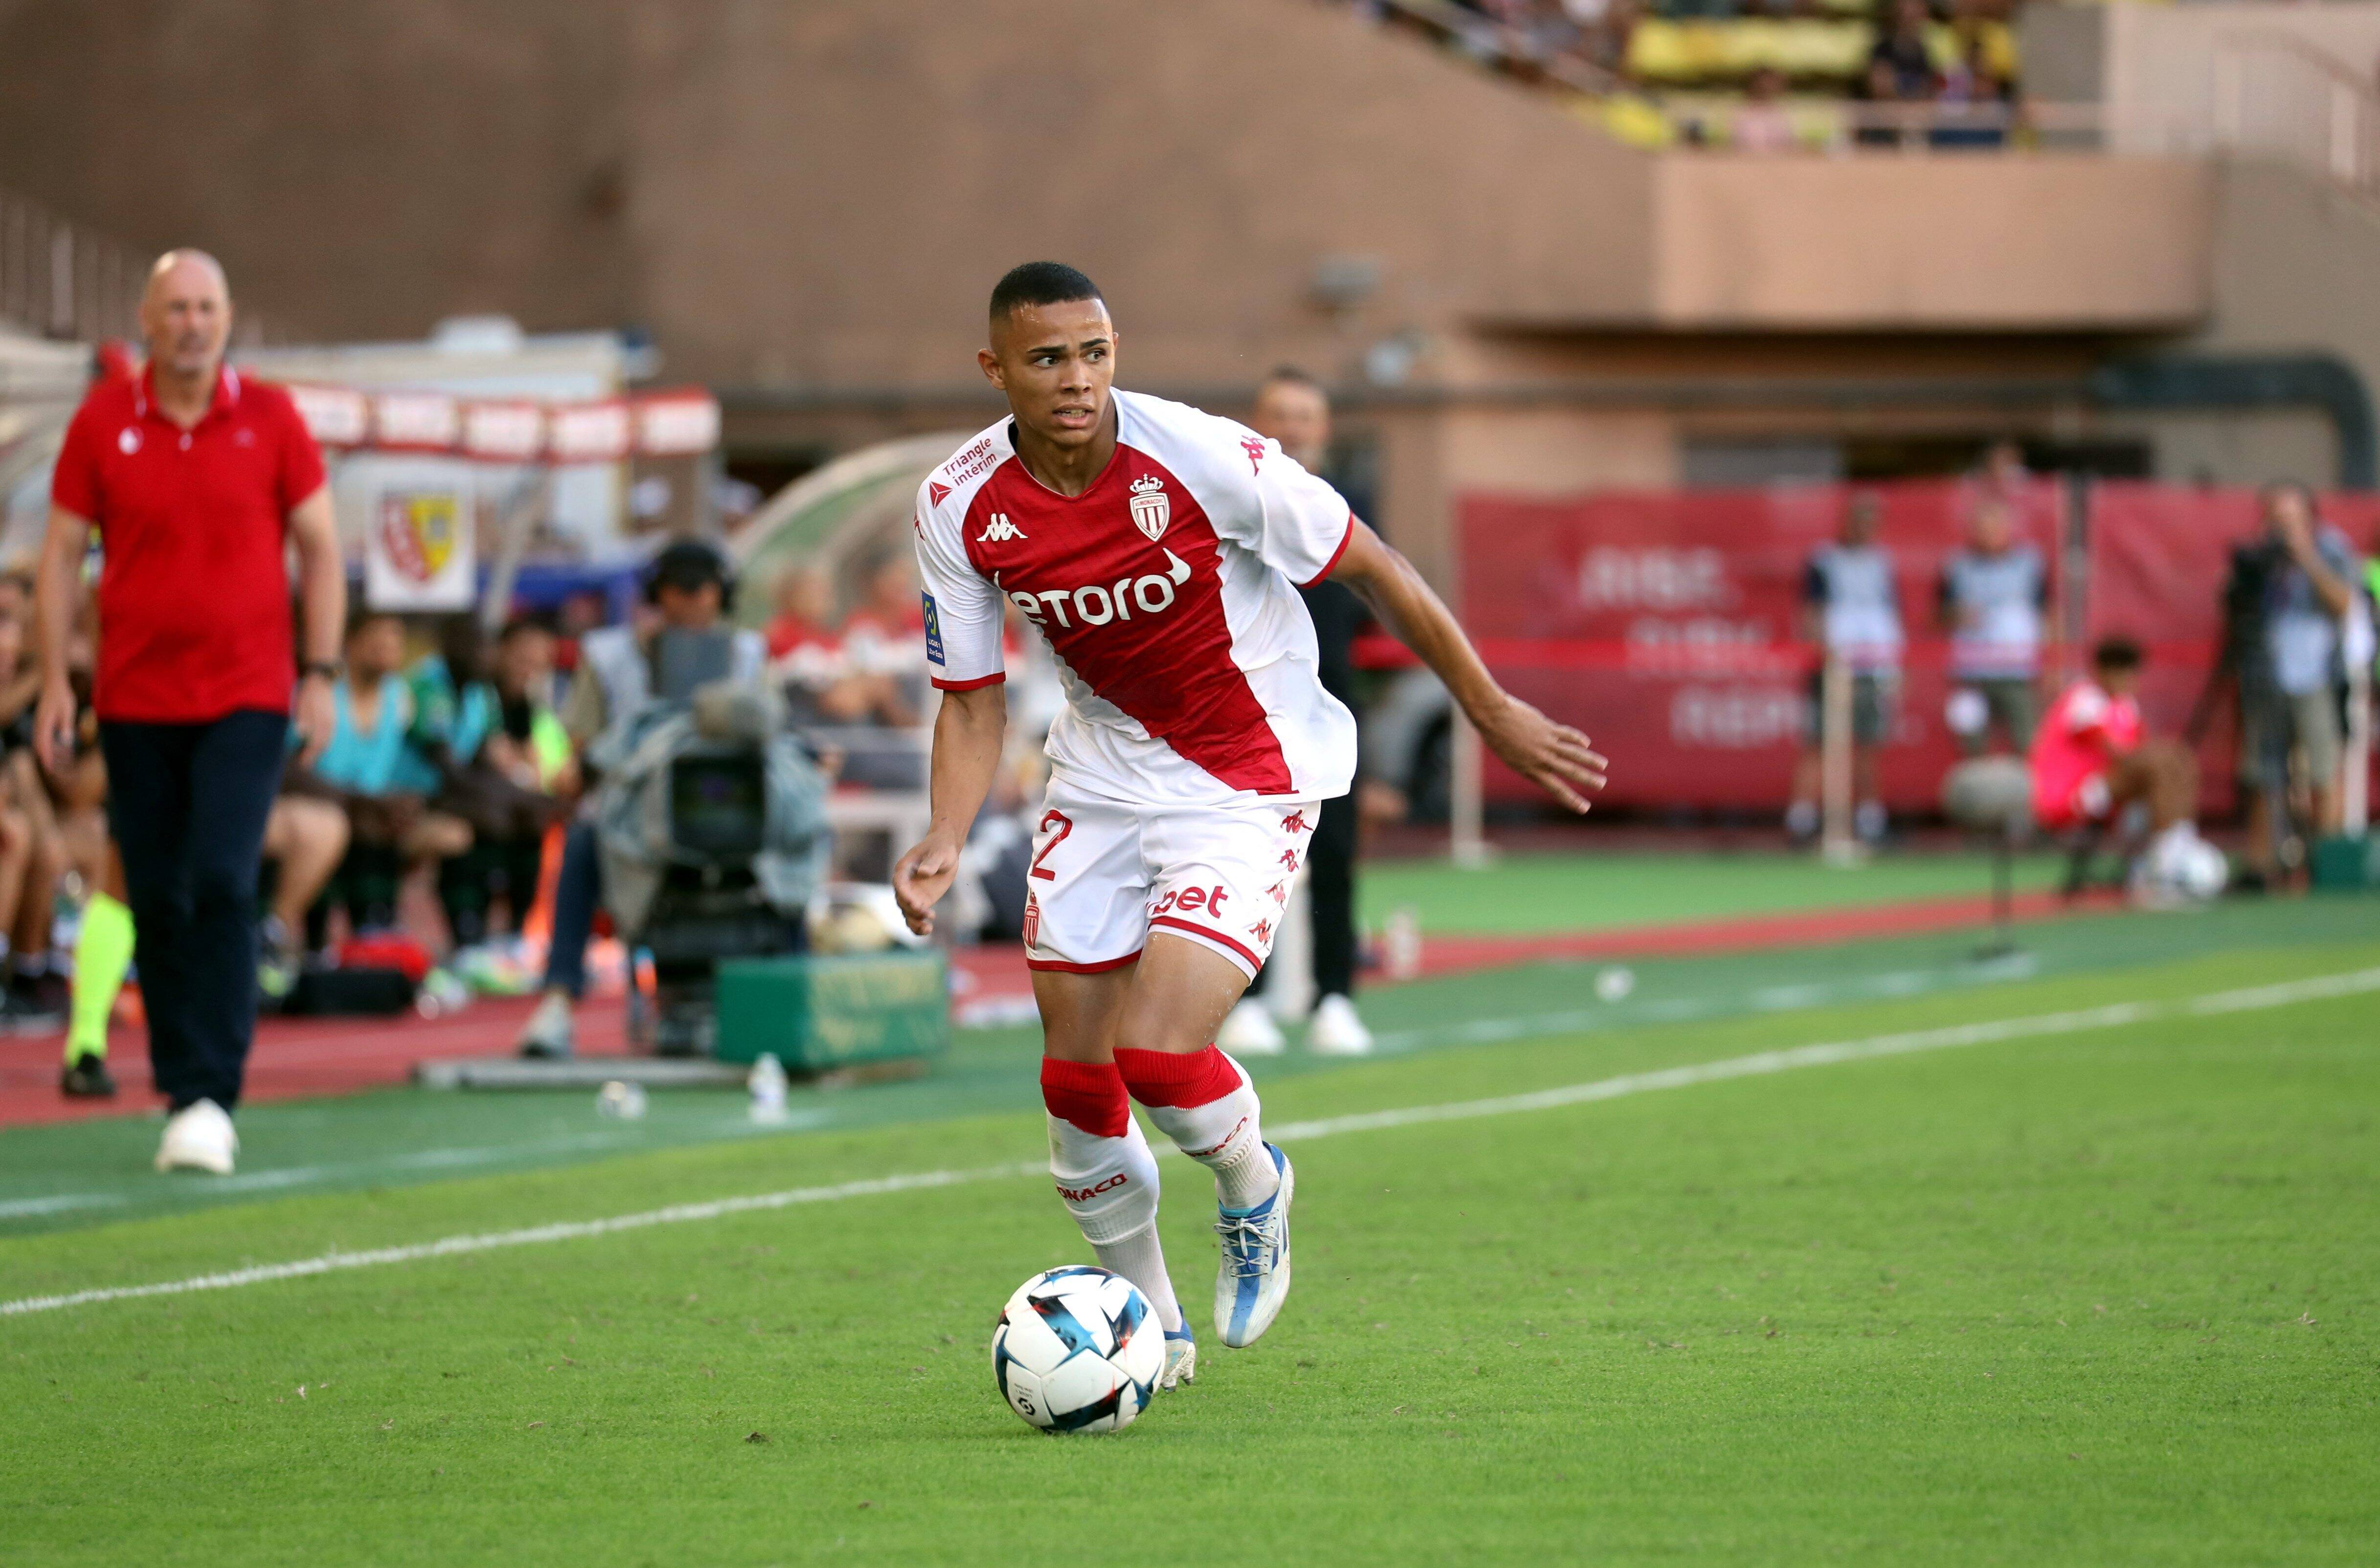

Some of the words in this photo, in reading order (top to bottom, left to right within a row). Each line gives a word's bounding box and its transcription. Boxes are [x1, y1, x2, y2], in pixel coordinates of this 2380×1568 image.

[943, 438, 992, 476] Triangle
[952, 453, 997, 486] intérim
[1030, 809, 1072, 881] 2
[1057, 1174, 1128, 1202] ONACO
